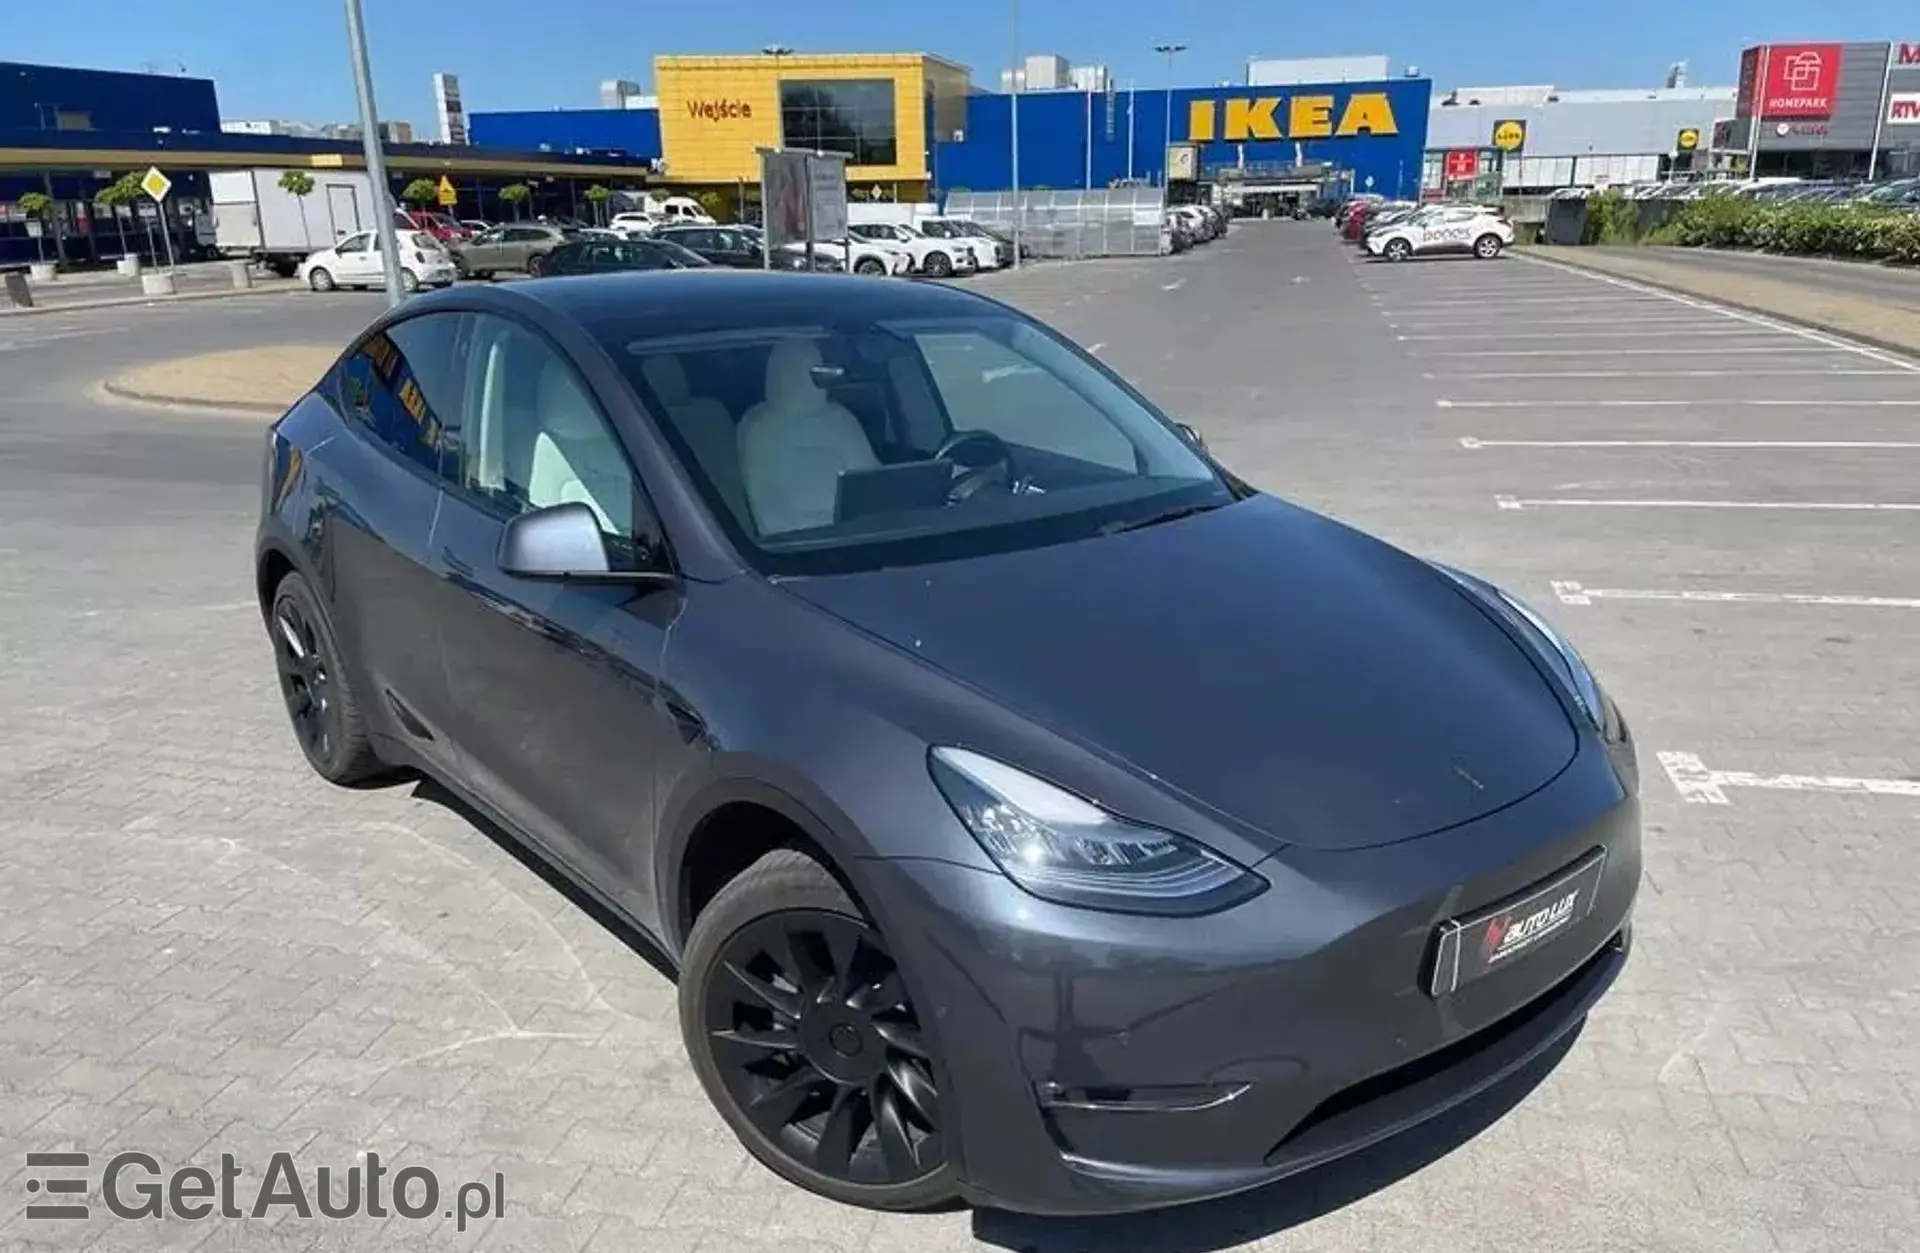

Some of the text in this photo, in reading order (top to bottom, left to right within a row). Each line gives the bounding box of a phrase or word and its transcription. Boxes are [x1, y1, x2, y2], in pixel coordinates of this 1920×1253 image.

[686, 97, 752, 123] Wejście
[1768, 97, 1828, 109] HOMEPARK
[1189, 93, 1398, 140] IKEA
